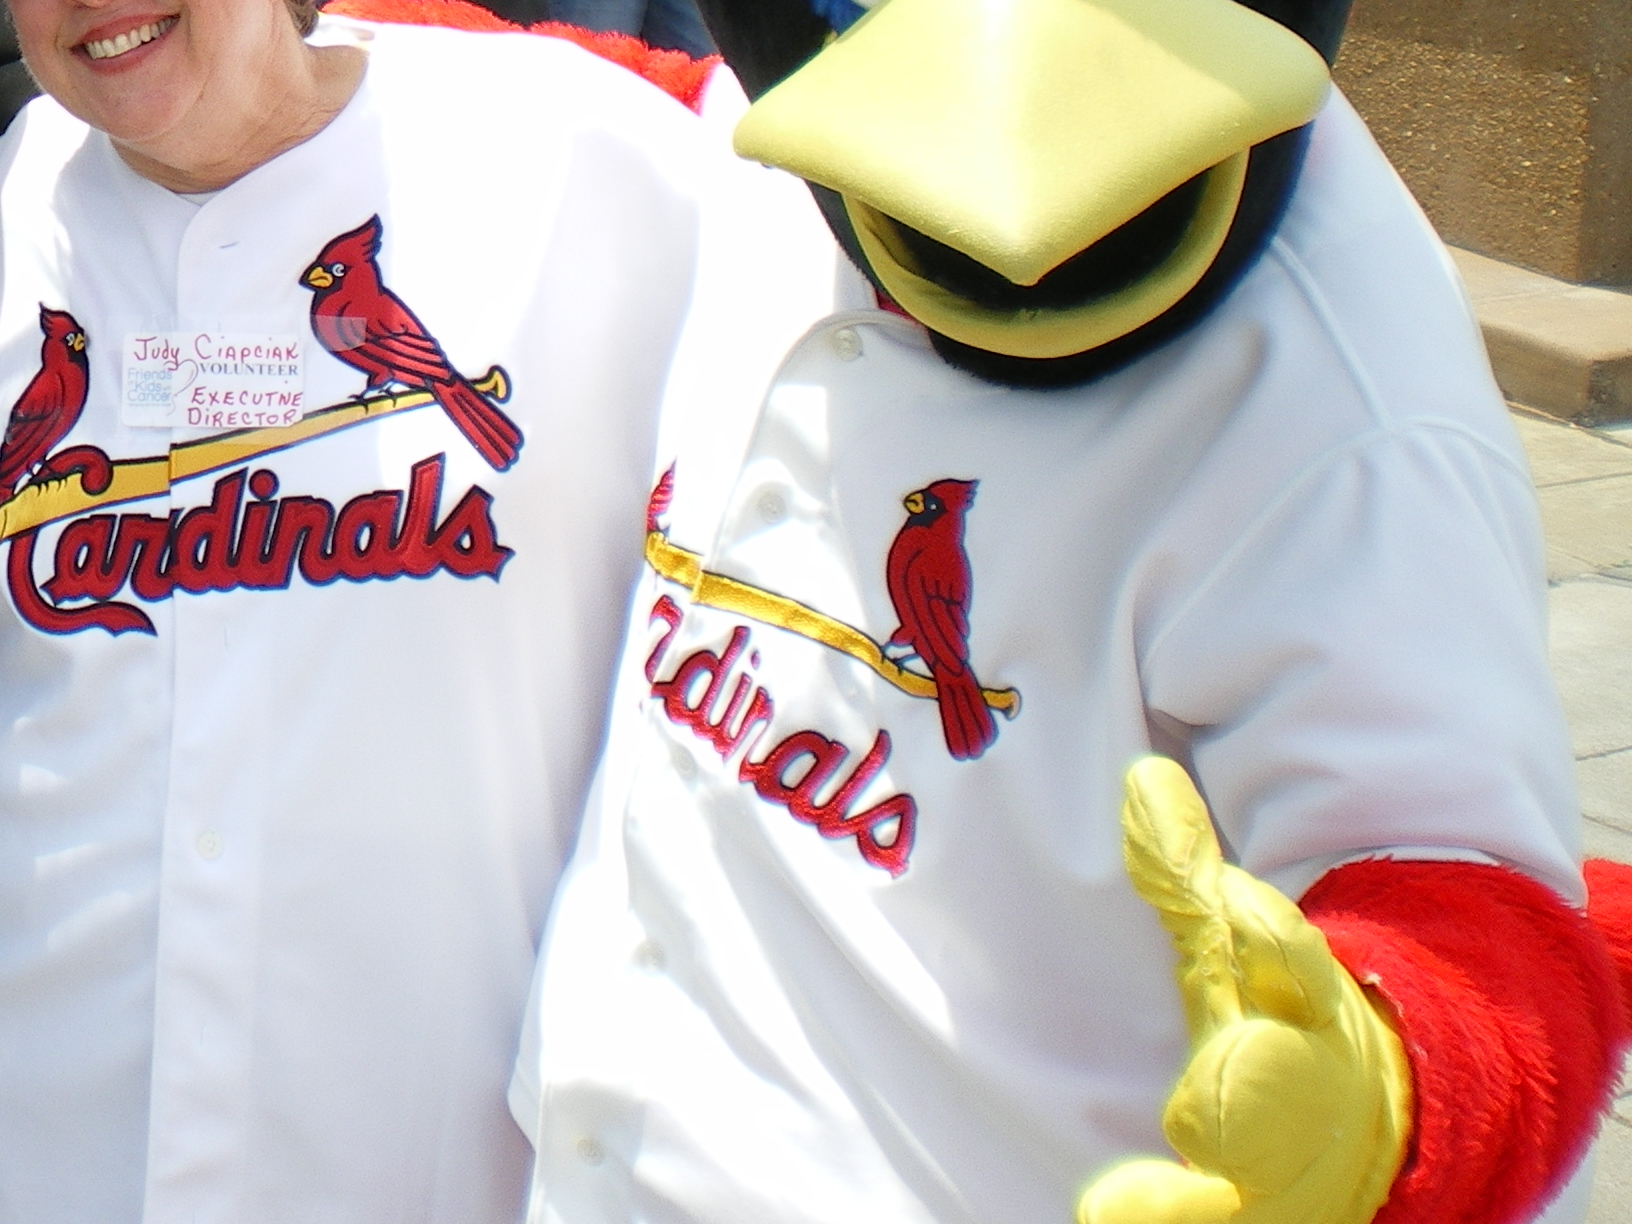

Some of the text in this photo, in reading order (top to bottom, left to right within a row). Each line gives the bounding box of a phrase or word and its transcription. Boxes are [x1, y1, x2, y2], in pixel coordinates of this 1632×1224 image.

[134, 336, 180, 371] Judy
[199, 362, 299, 376] VOLUNTEER
[7, 445, 516, 637] Cardinals
